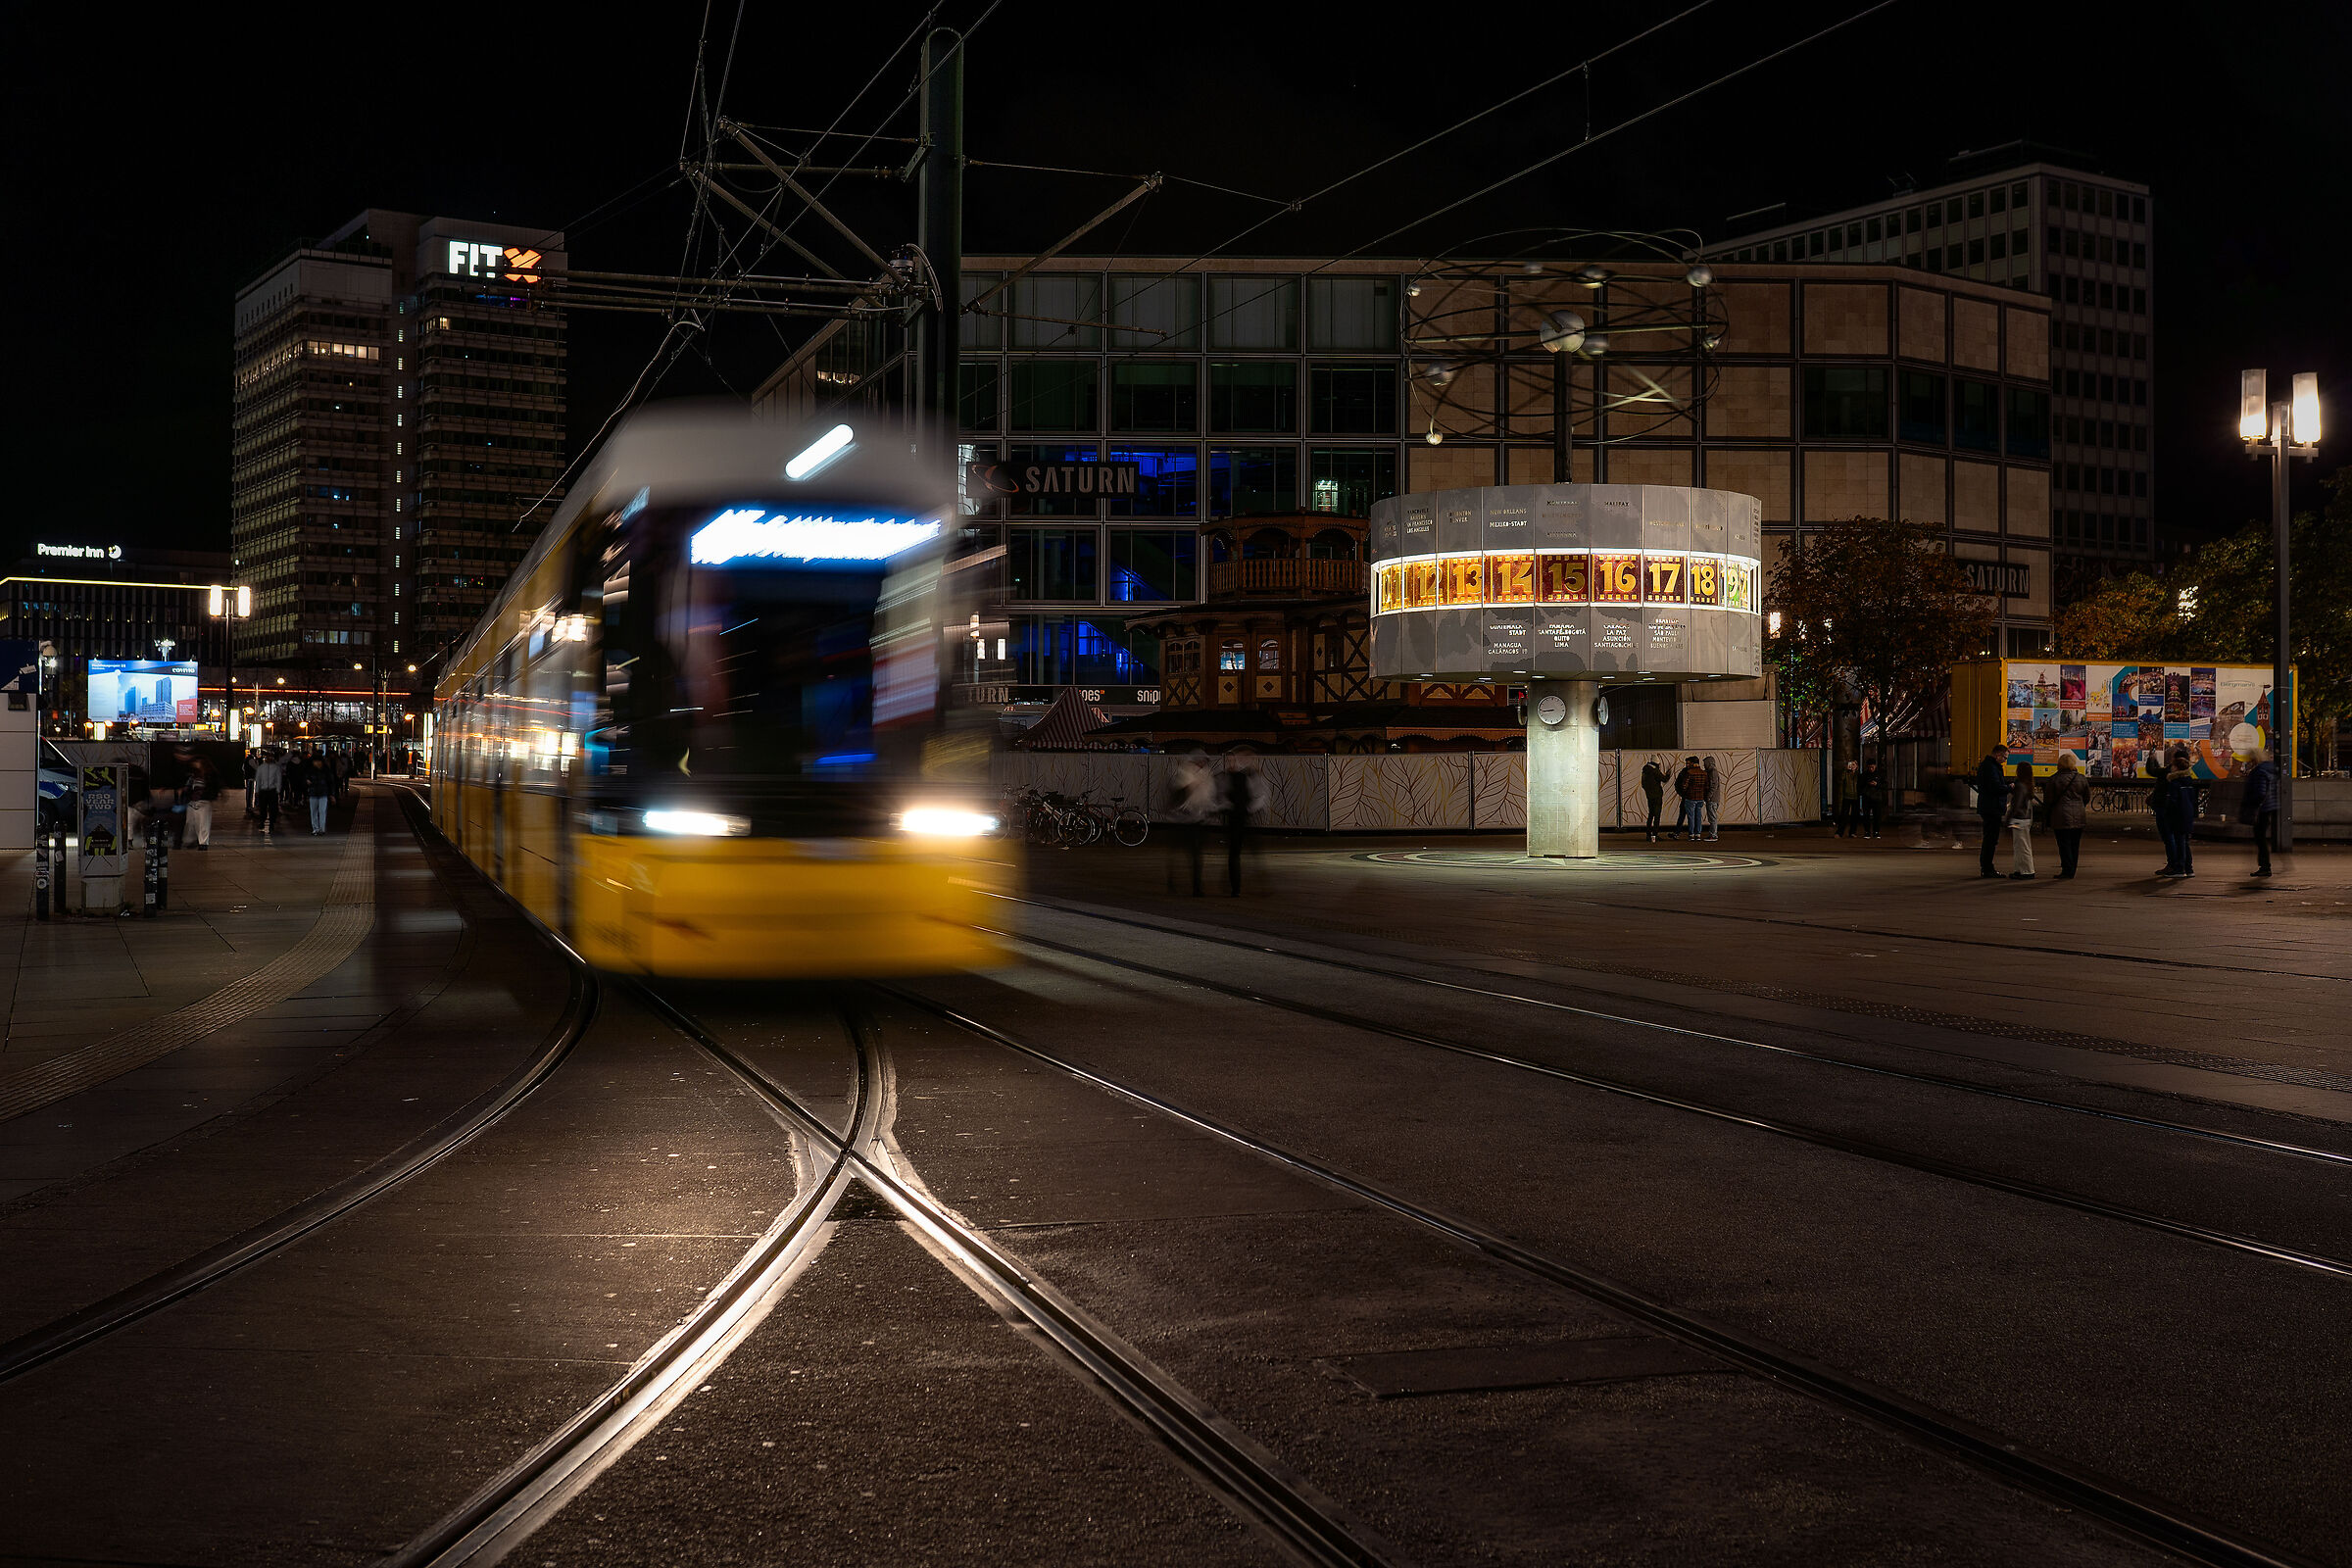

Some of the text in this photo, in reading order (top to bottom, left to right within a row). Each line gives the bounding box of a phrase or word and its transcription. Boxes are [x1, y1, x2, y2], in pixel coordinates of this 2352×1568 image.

[1025, 466, 1135, 493] SATURN
[37, 543, 104, 558] Premier Inn
[1417, 568, 1443, 597] 12
[1452, 564, 1483, 595] 13
[1497, 563, 1533, 593] 14
[1547, 563, 1586, 593] 15
[1599, 562, 1637, 593] 16
[1648, 563, 1682, 593] 17
[1690, 565, 1715, 596] 18
[1966, 564, 2030, 594] SATURN
[1137, 689, 1160, 705] snip
